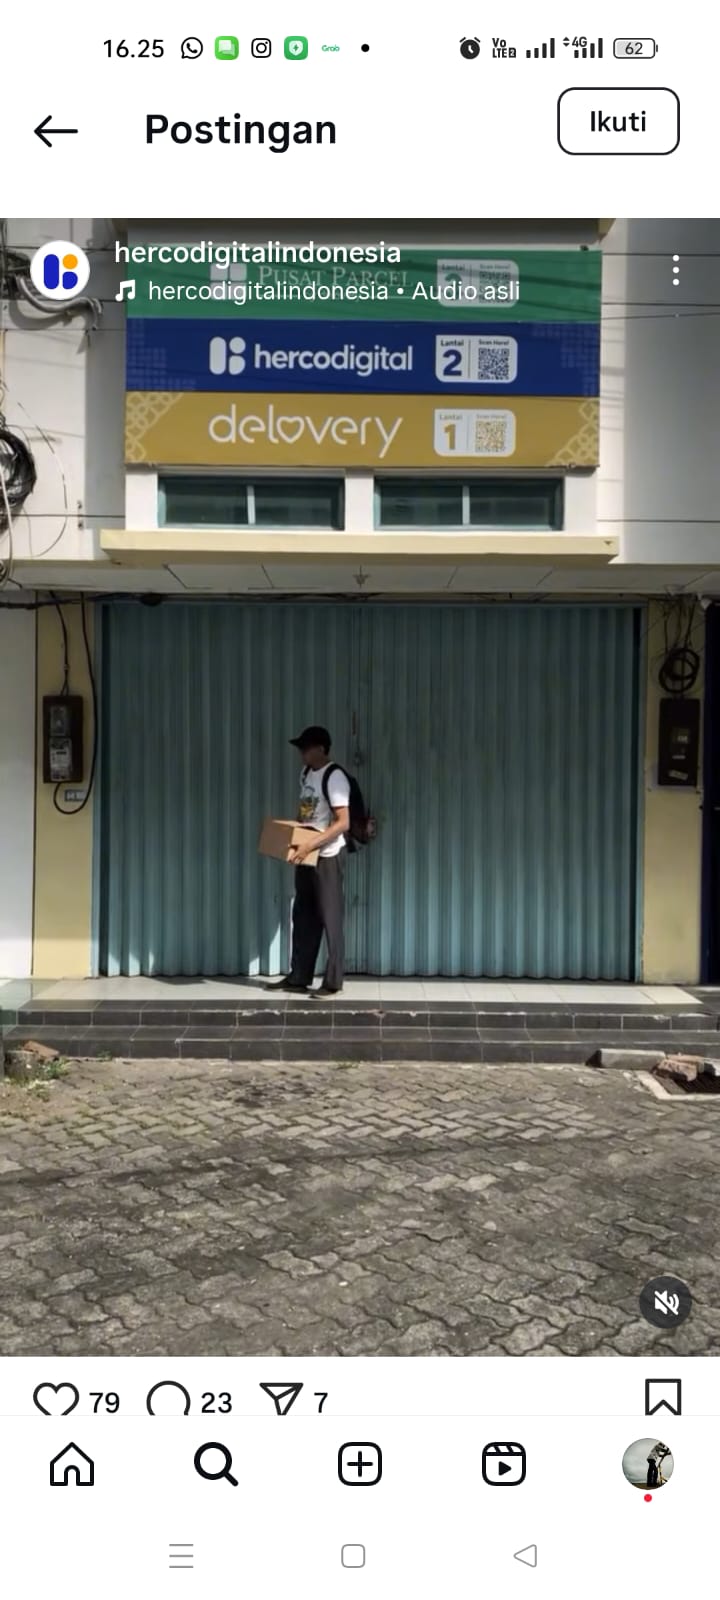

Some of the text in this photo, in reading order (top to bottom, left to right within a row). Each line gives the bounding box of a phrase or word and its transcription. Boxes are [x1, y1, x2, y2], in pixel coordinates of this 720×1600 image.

[259, 266, 414, 287] PUSAT PARCEL
[254, 343, 413, 377] hercodigital
[443, 350, 462, 376] 2
[208, 404, 403, 459] delovery
[444, 423, 456, 451] 1
